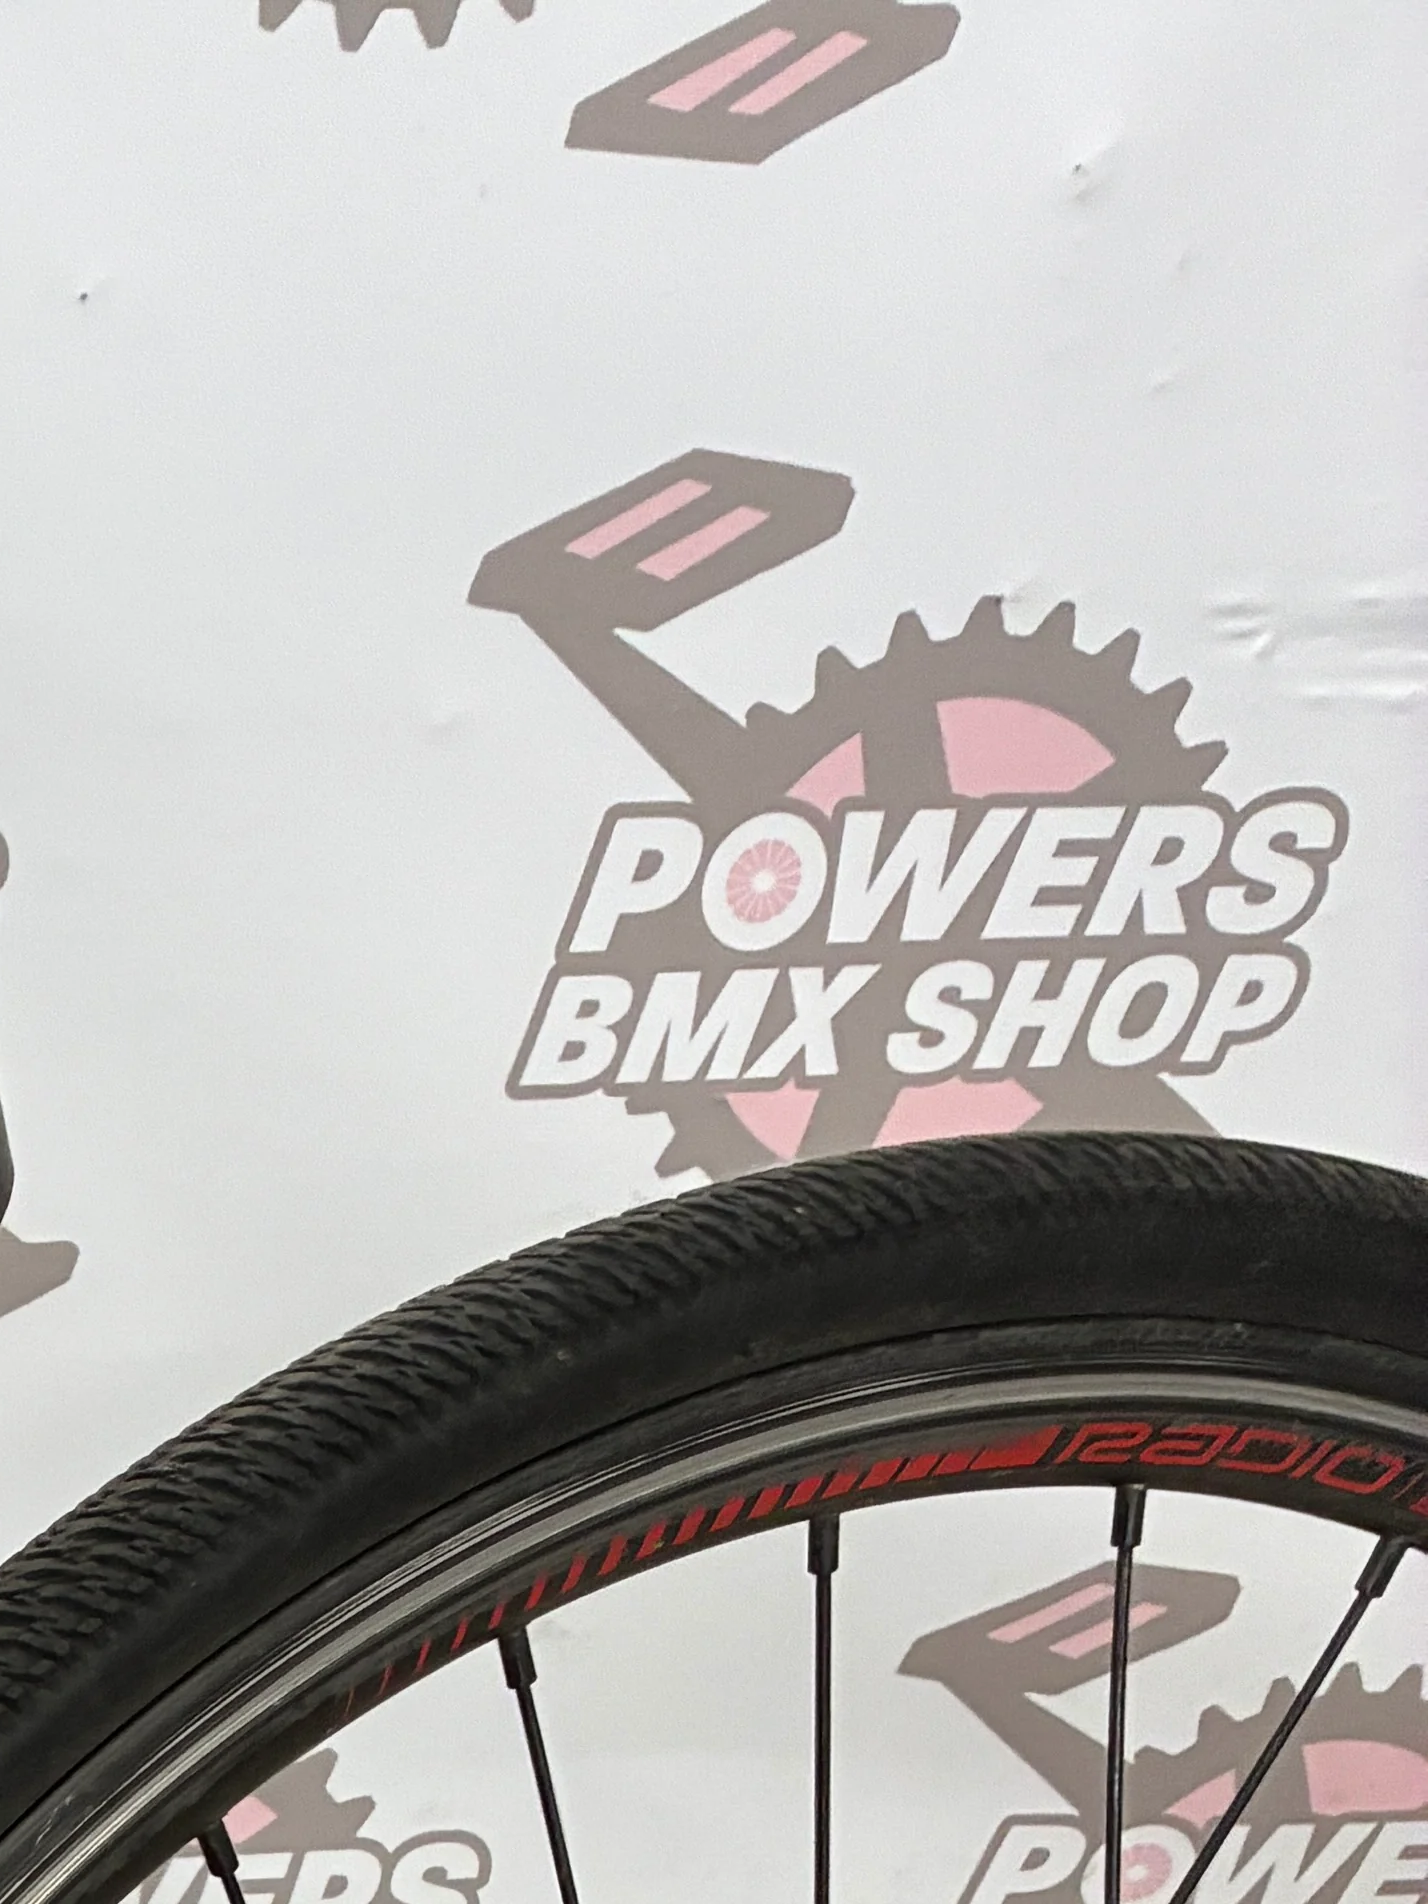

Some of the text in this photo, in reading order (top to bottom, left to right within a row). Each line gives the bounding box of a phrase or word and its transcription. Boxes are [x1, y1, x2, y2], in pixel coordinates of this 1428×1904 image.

[568, 801, 1337, 953] POWERS
[517, 951, 1298, 1087] BMX SHOP
